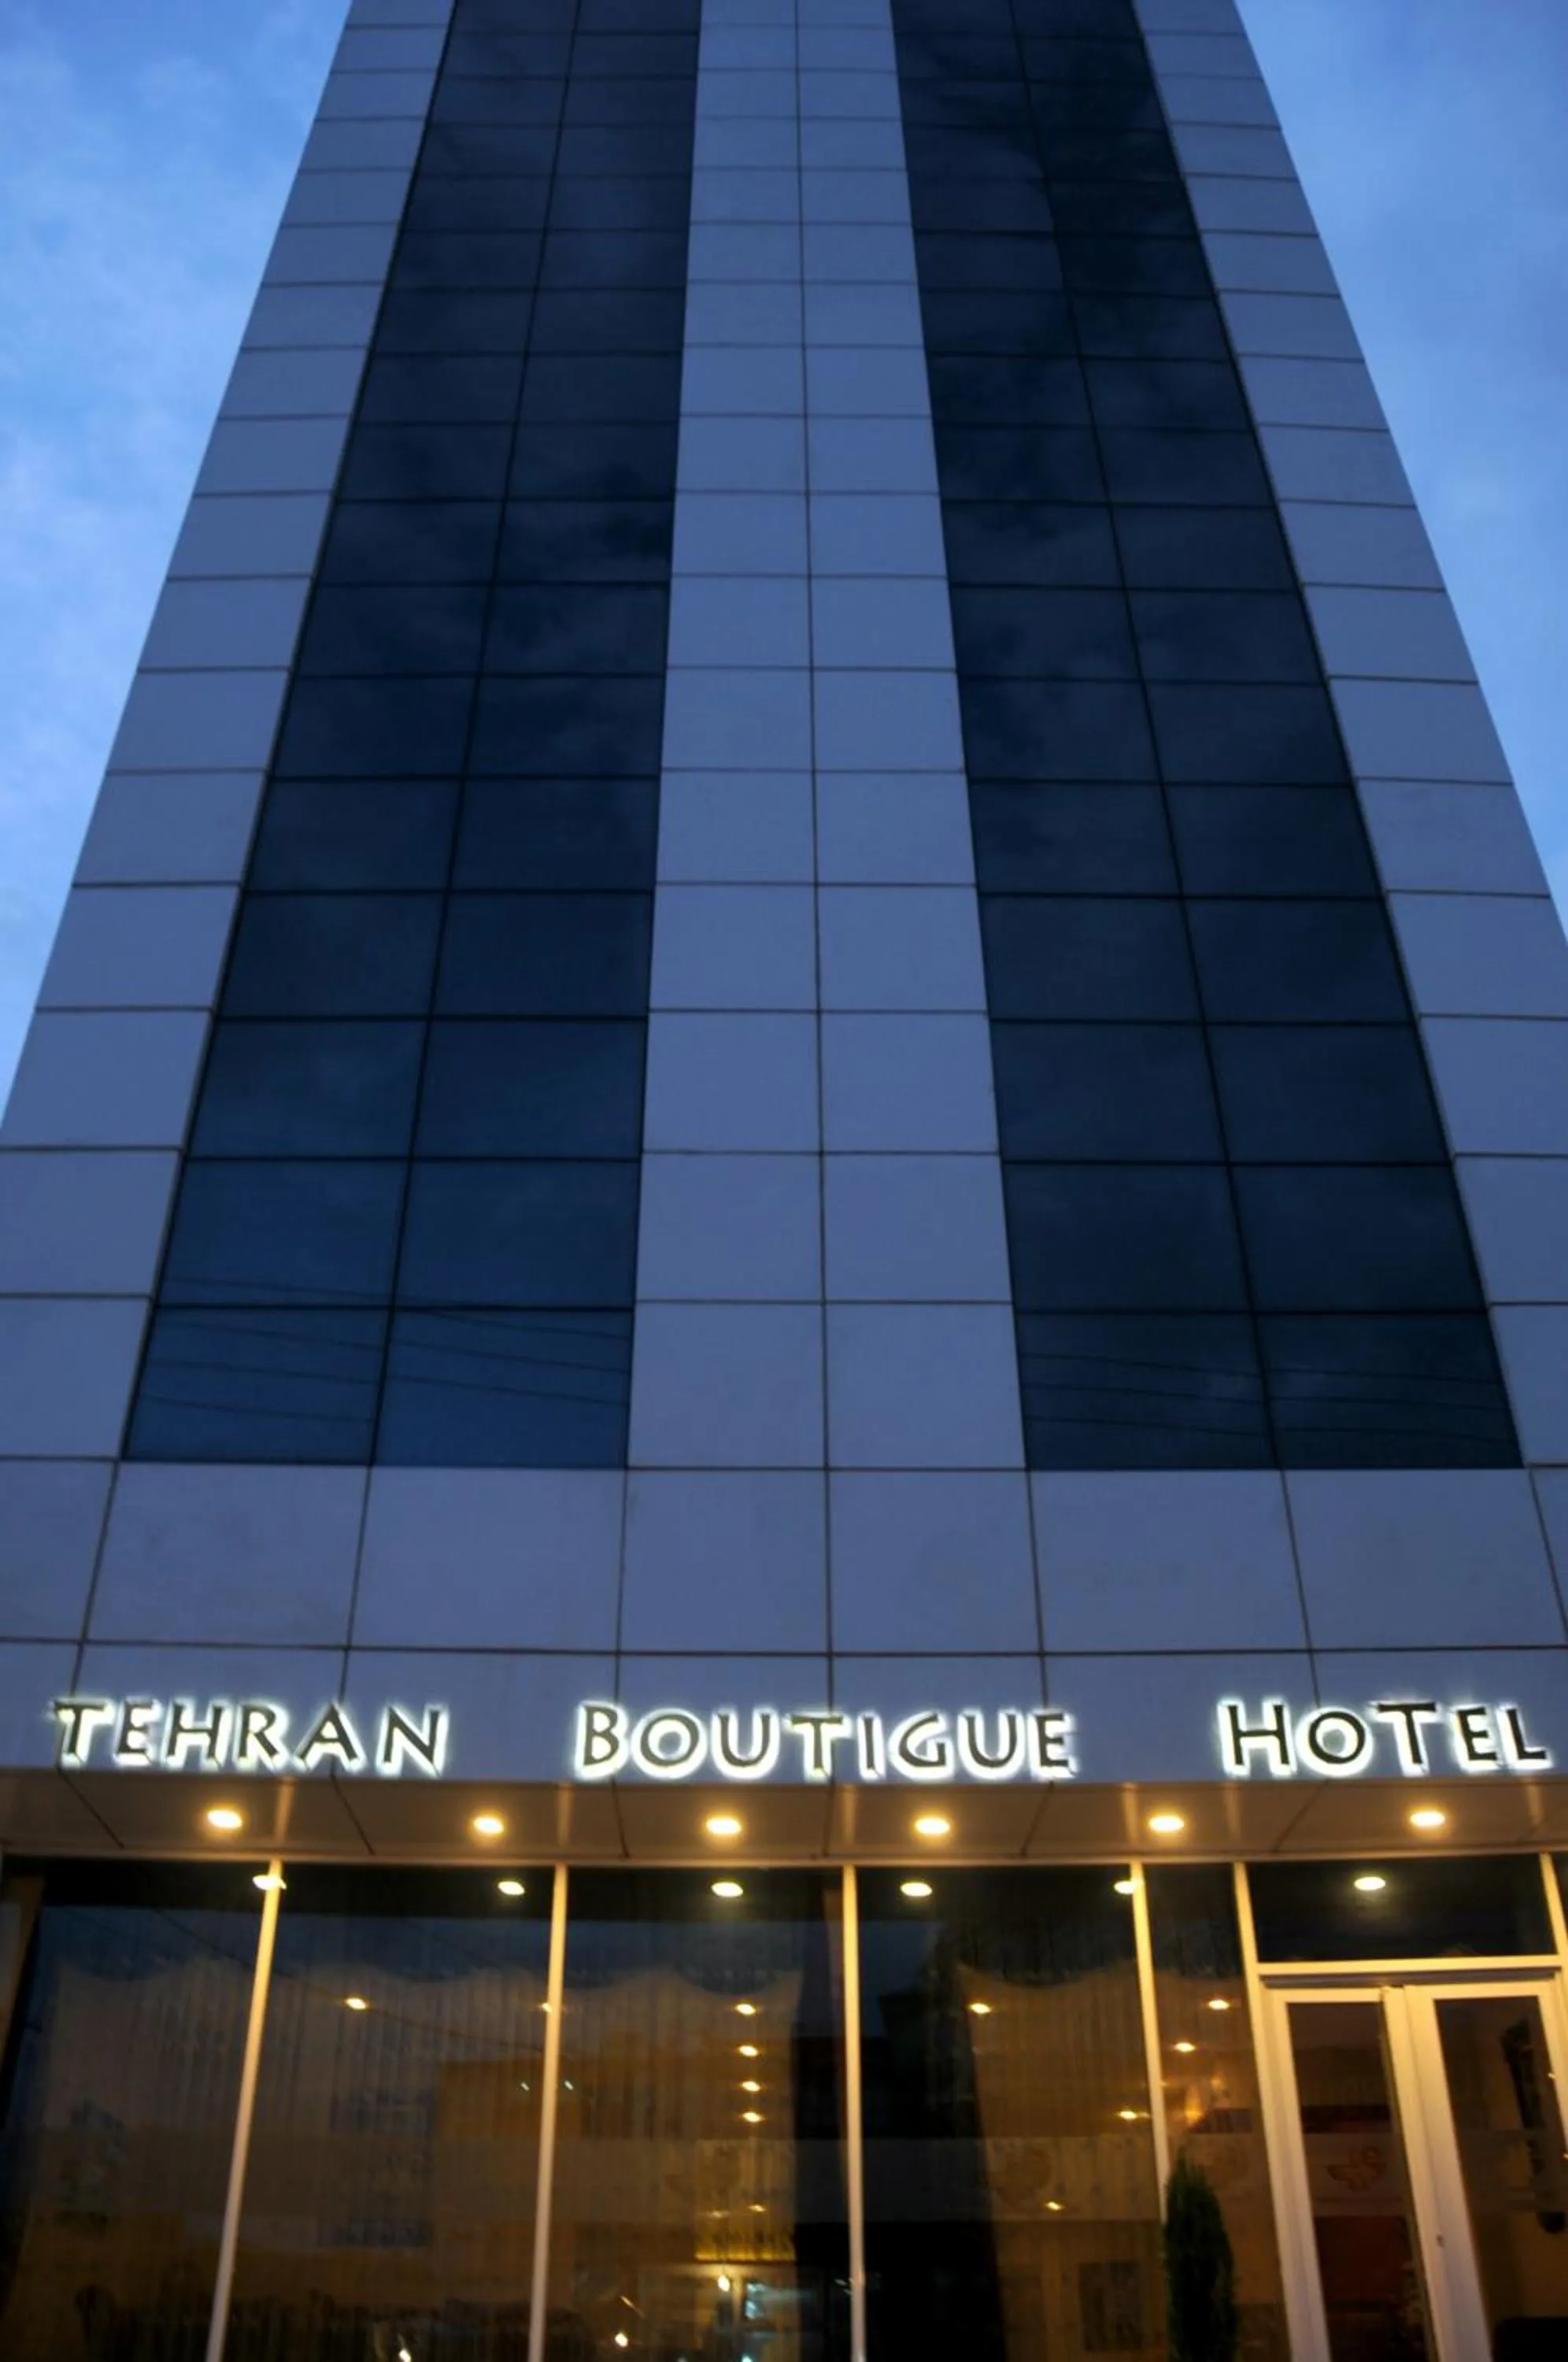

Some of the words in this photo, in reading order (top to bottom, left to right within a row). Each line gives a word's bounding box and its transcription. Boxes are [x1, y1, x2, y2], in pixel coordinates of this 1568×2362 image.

[51, 1699, 446, 1776] TEHRAN
[579, 1703, 1077, 1775] BOUTIGUE
[1223, 1700, 1551, 1772] HOTEL
